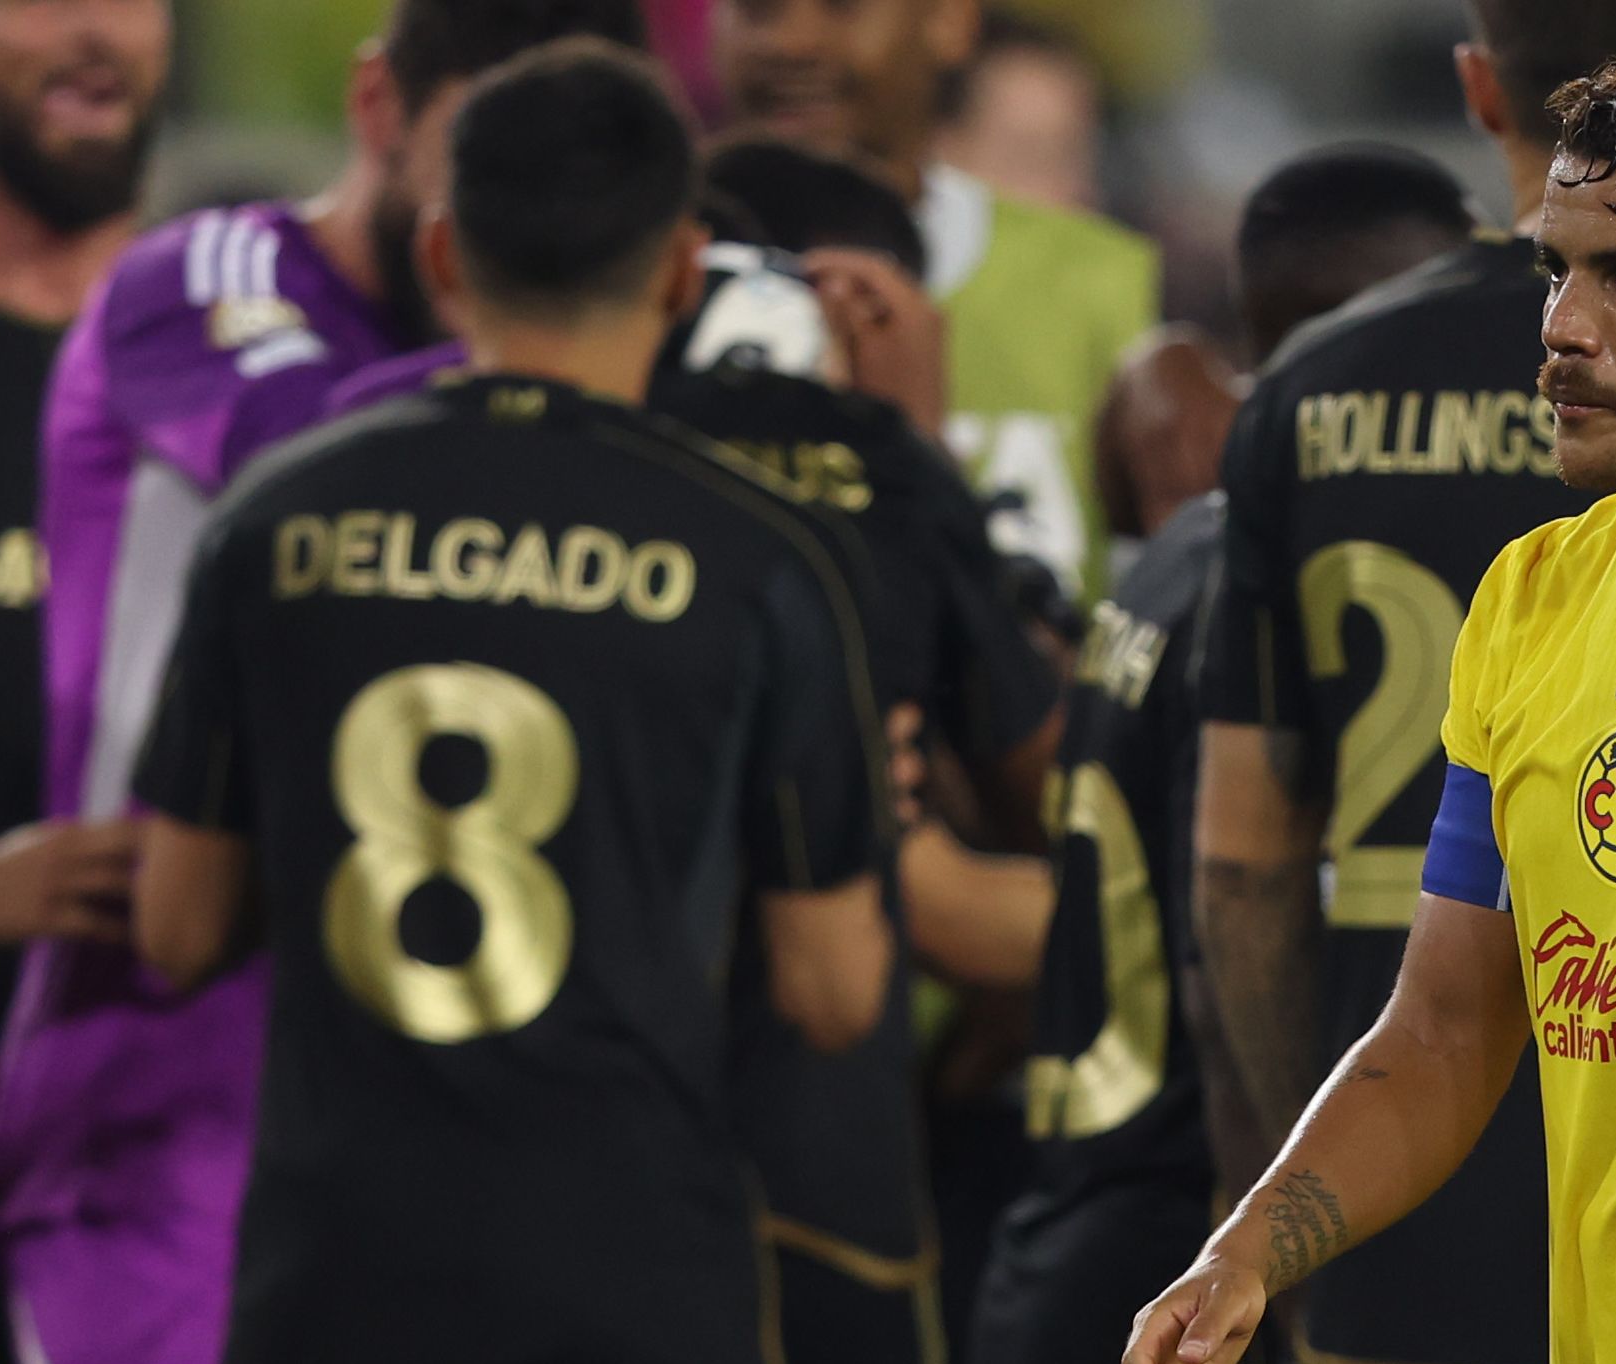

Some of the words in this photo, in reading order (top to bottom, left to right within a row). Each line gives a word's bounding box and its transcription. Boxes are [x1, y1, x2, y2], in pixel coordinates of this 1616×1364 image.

[1297, 390, 1559, 481] HOLLINGS
[275, 509, 696, 622] DELGADO
[321, 661, 579, 1044] 8
